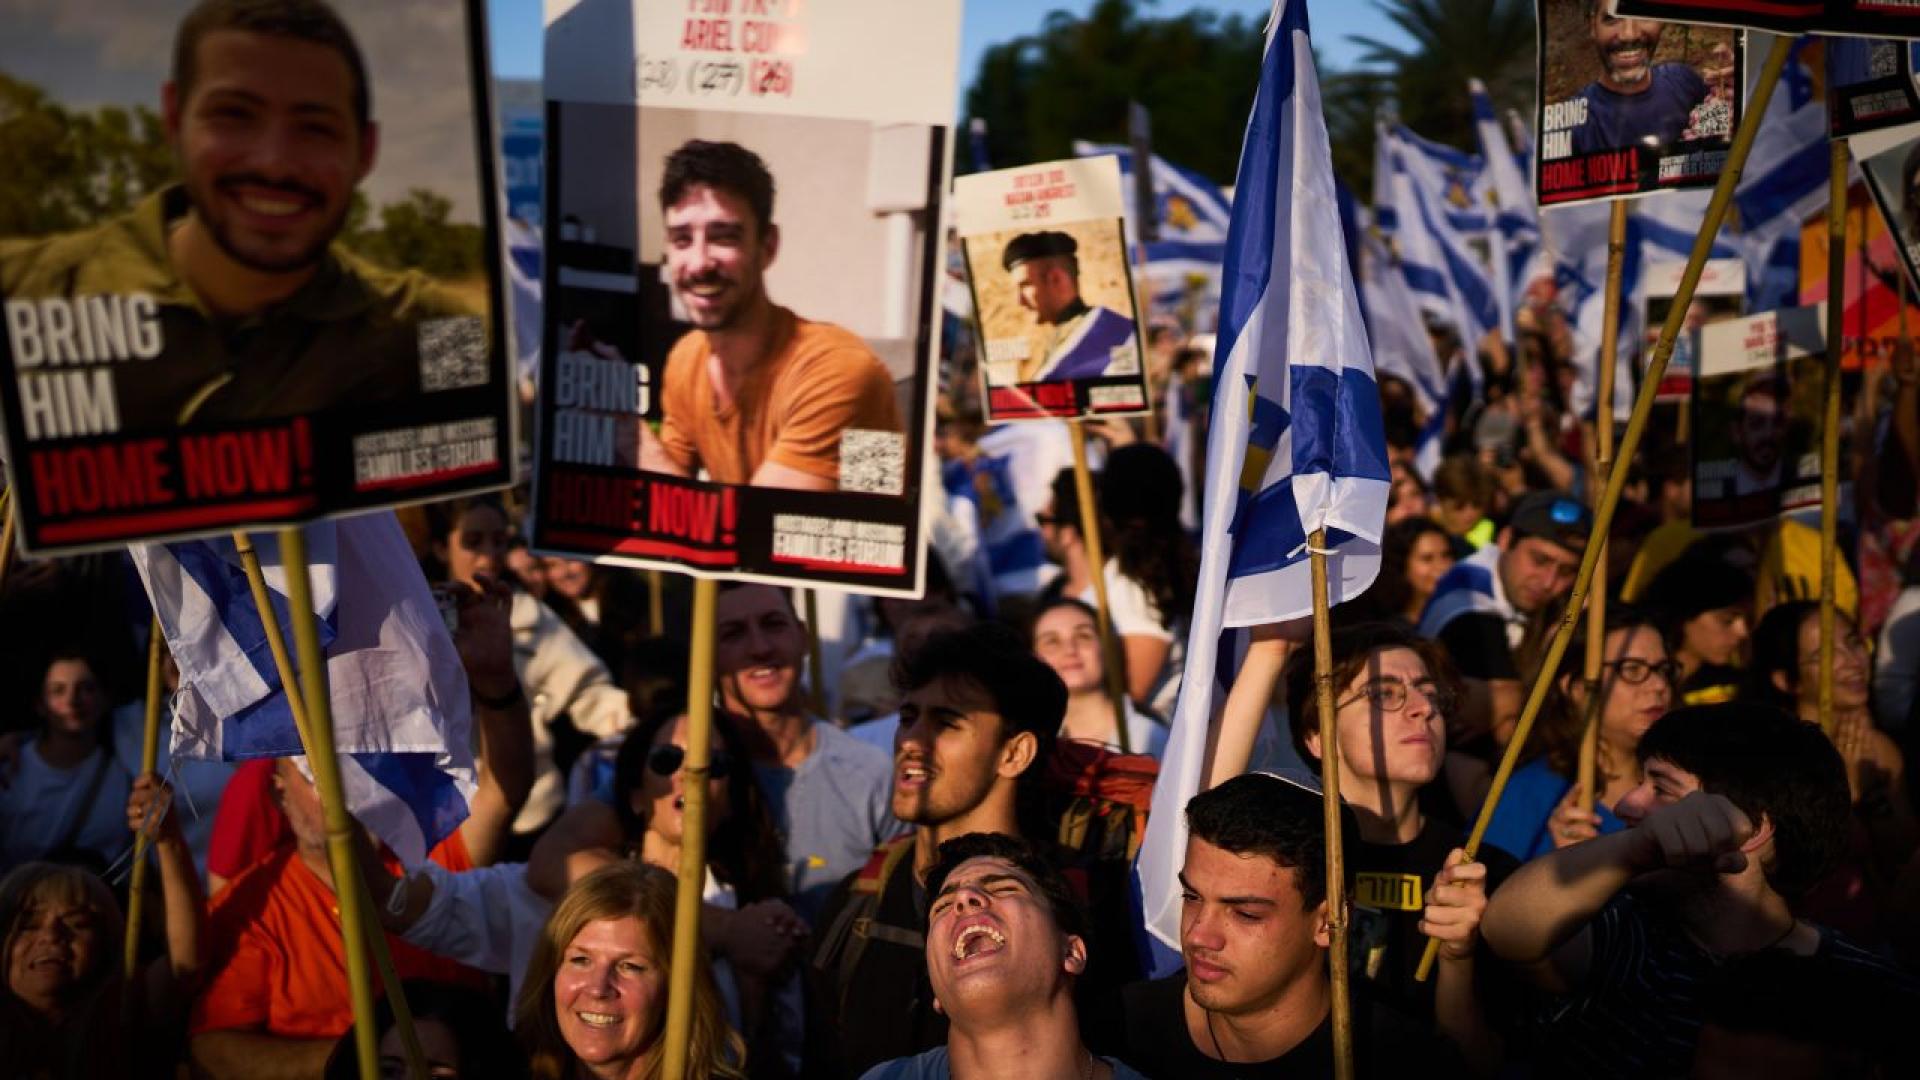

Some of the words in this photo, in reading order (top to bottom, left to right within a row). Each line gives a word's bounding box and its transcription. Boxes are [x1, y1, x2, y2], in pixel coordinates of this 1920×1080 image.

[681, 18, 734, 52] ARIEL
[1545, 97, 1588, 131] BRING
[1542, 130, 1572, 160] HIM
[1542, 159, 1584, 190] HOME
[1587, 147, 1637, 182] NOW!
[5, 294, 164, 367] BRING
[20, 369, 120, 440] HIM
[554, 350, 650, 415] BRING
[31, 440, 176, 515] HOME
[178, 415, 313, 500] NOW!
[552, 410, 615, 466] HIM
[547, 471, 644, 532] HOME
[647, 481, 737, 546] NOW!
